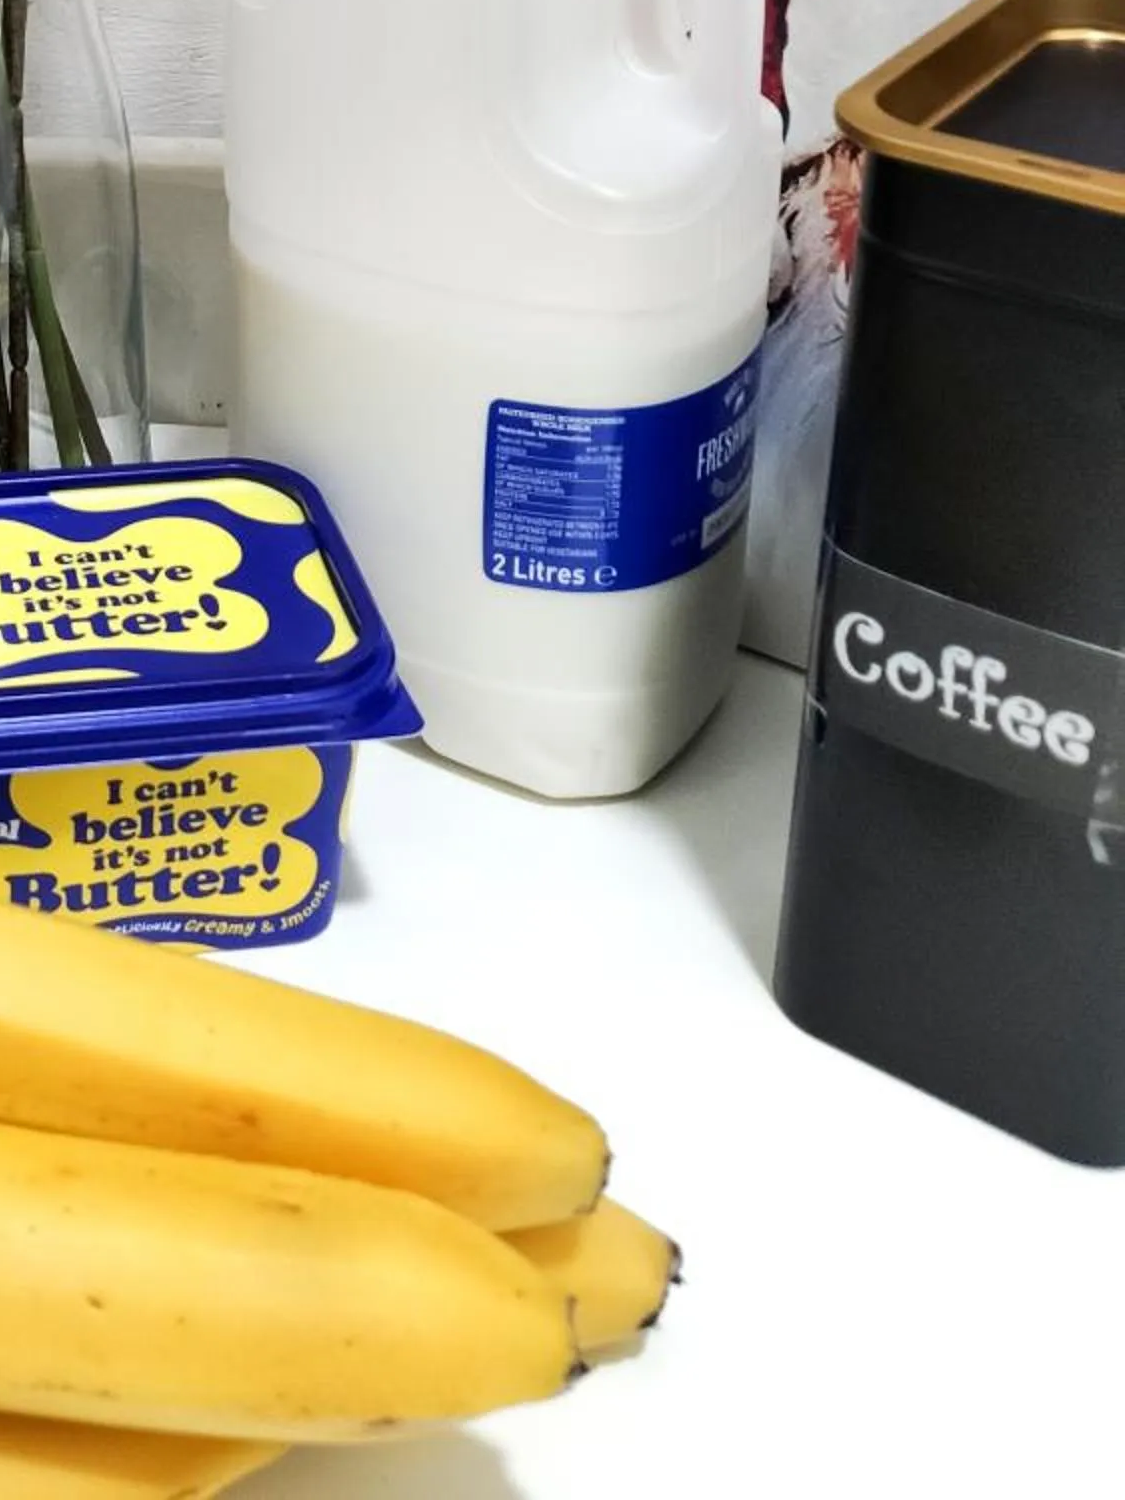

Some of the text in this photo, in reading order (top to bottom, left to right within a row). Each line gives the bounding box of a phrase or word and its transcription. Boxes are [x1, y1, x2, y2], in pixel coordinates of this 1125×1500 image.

[27, 544, 155, 567] I can't
[491, 553, 506, 576] 2
[512, 556, 586, 586] Litres
[24, 589, 162, 613] it's not
[833, 611, 1096, 766] Coffee
[107, 770, 239, 805] I can't
[71, 802, 269, 845] believe
[92, 836, 230, 872] it's not
[4, 841, 282, 913] Butter!
[184, 918, 257, 937] Creamy
[260, 920, 275, 934] &
[280, 880, 332, 931] Smooth
